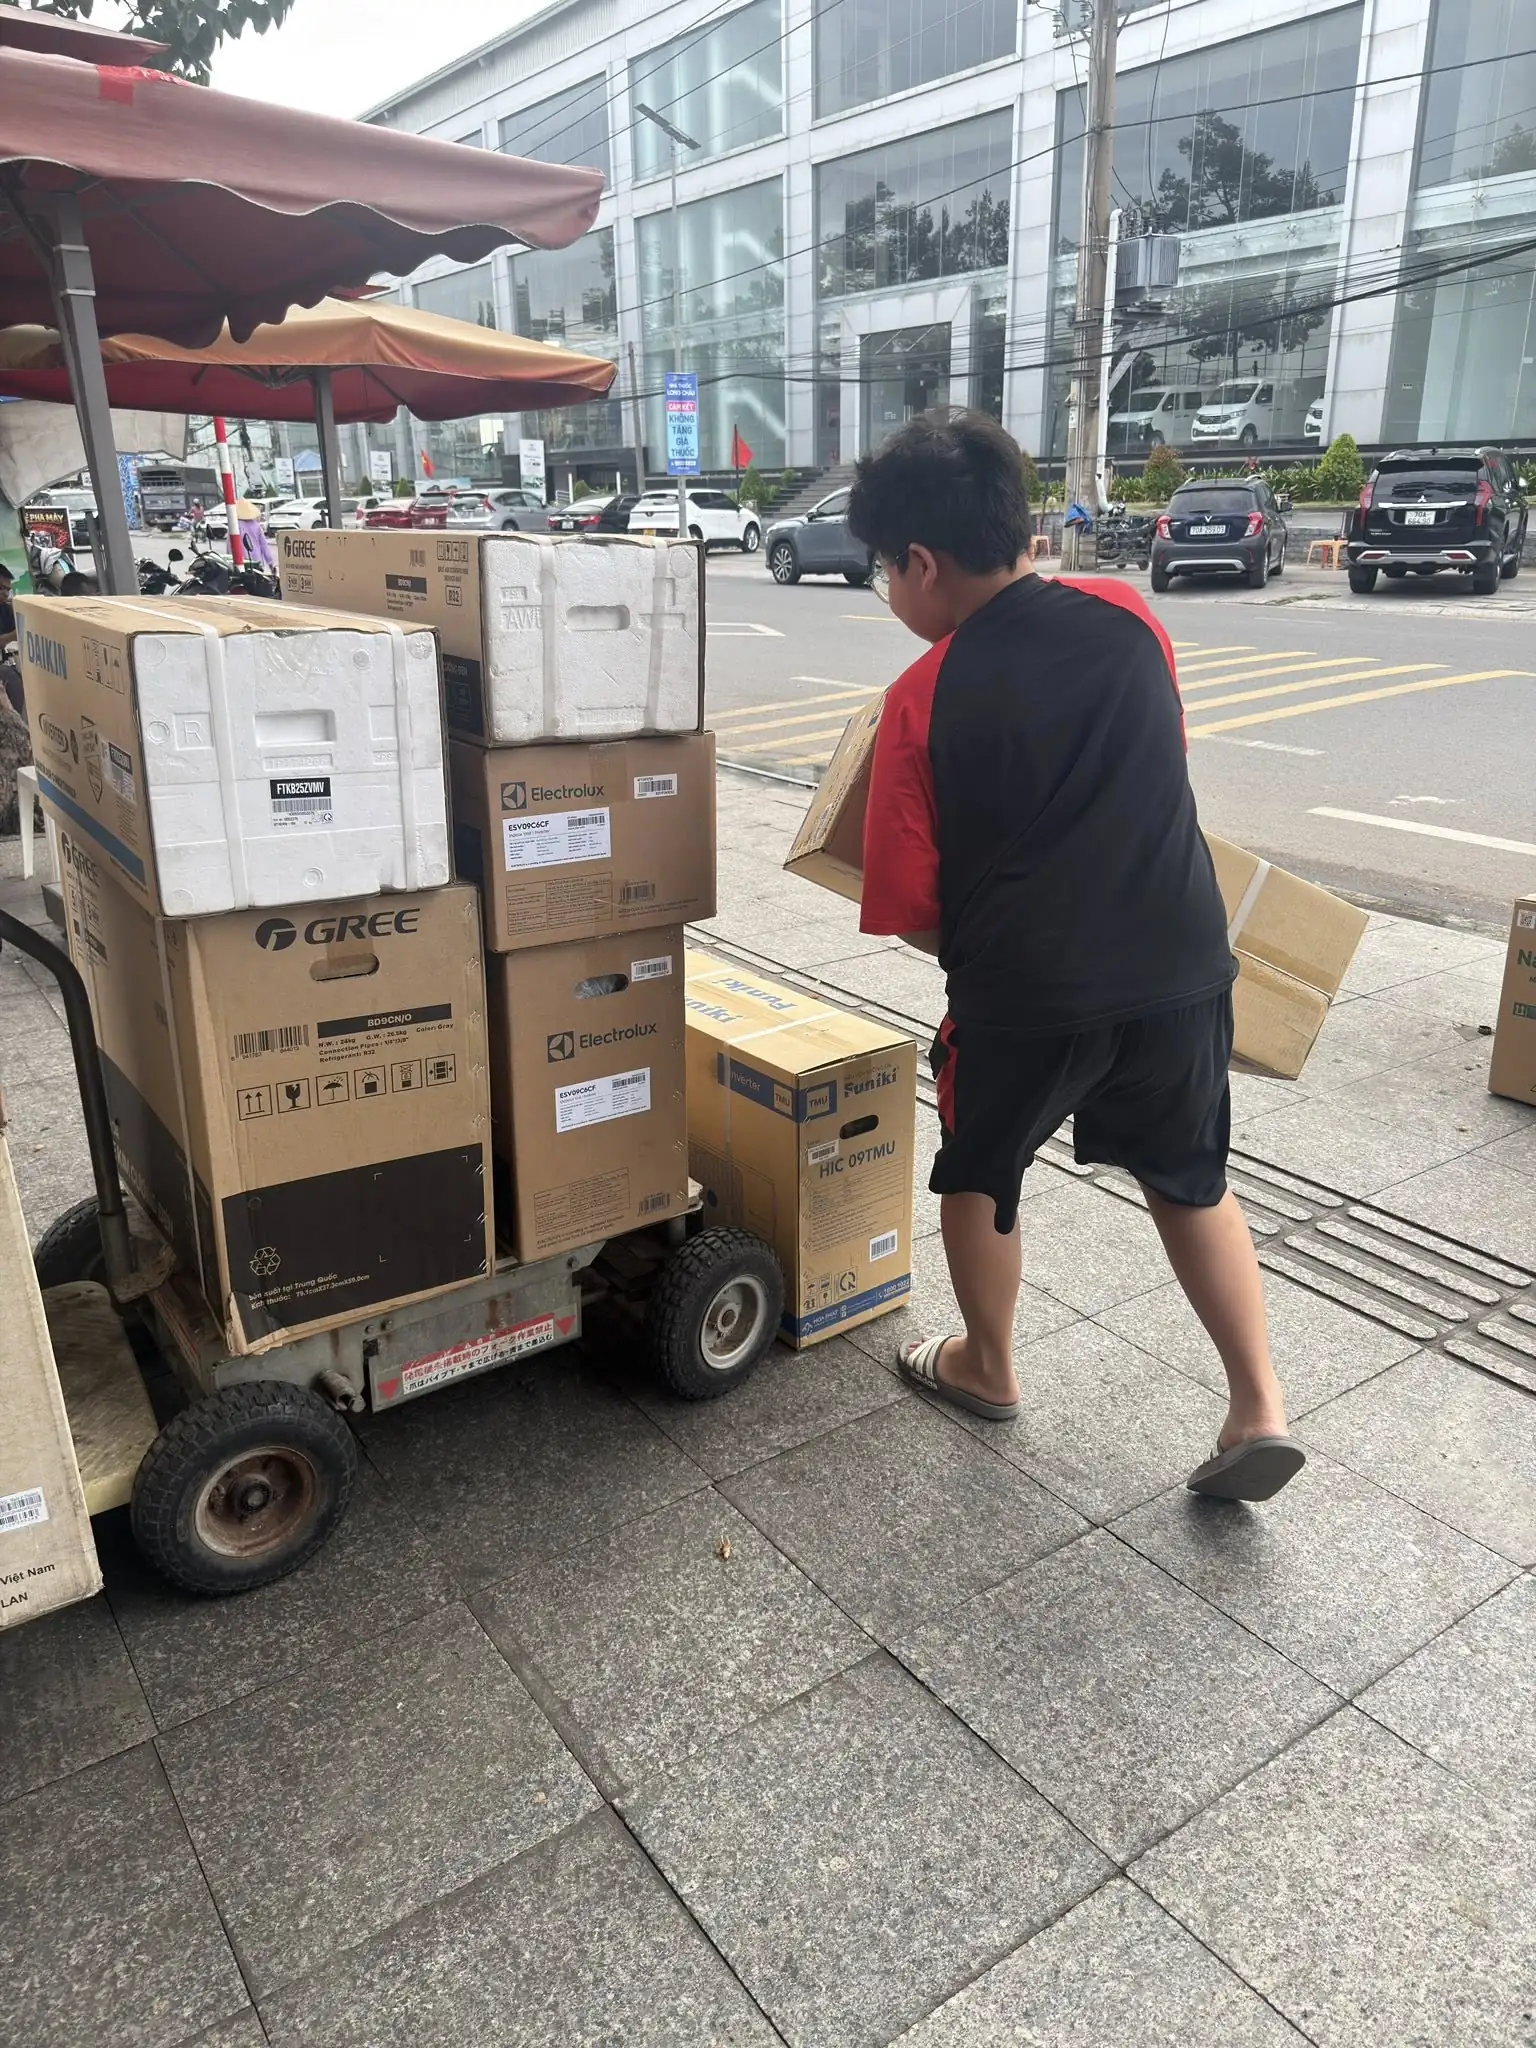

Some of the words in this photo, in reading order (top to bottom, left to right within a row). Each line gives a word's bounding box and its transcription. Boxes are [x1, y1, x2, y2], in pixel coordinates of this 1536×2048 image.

[669, 413, 695, 423] KHÔNG
[672, 425, 693, 435] TĂNG
[671, 447, 695, 457] THUỐC
[292, 539, 316, 559] GREE
[27, 630, 67, 680] DAIKIN
[276, 781, 324, 795] FTKB25ZVMV
[531, 783, 605, 802] Electrolux
[508, 820, 550, 832] ESV09C6CF
[304, 908, 420, 945] GREE
[712, 978, 798, 1011] Funiki
[438, 1022, 454, 1030] Gray
[579, 1022, 657, 1049] Electrolux
[319, 1045, 359, 1056] Connection
[844, 1067, 897, 1098] Funiki
[560, 1085, 597, 1099] ESV09C6CF
[809, 1095, 828, 1109] TMU
[819, 1158, 845, 1179] HIC
[848, 1140, 896, 1168] 09TMU
[294, 1279, 316, 1290] Trung
[317, 1272, 338, 1283] Quốc
[0, 1572, 25, 1586] Việt
[27, 1563, 56, 1579] Nam
[1, 1592, 29, 1608] LAN
